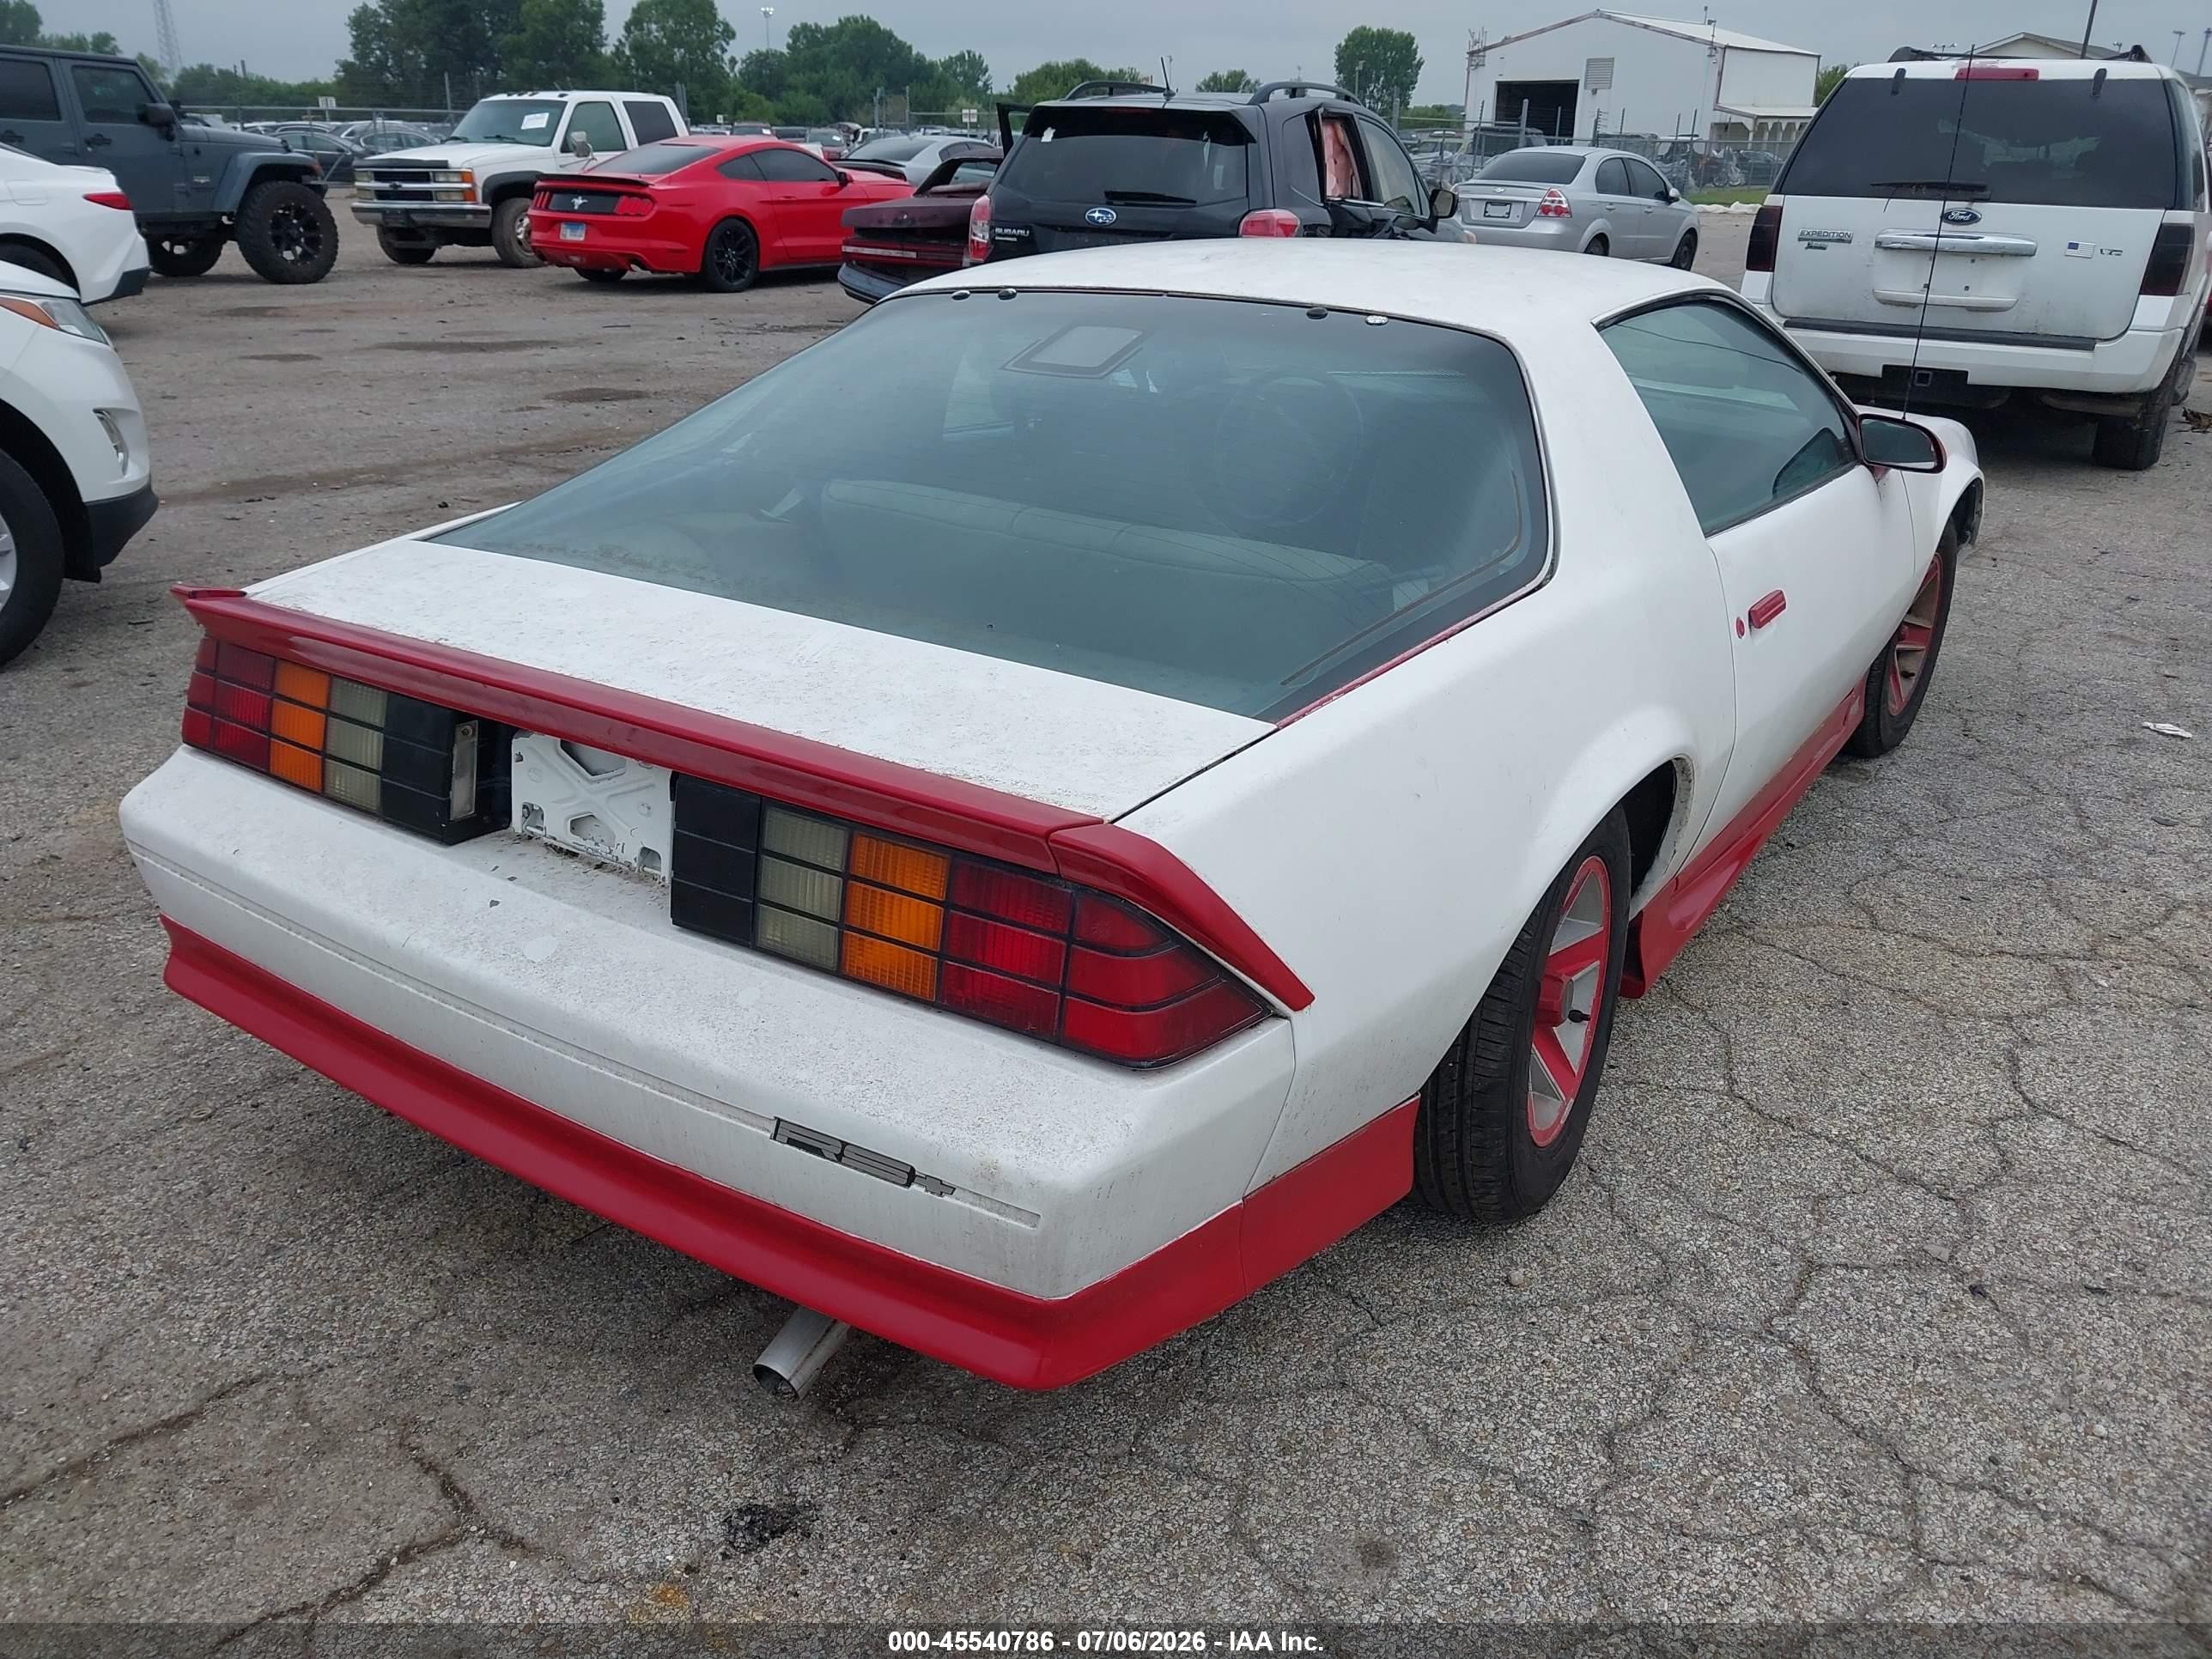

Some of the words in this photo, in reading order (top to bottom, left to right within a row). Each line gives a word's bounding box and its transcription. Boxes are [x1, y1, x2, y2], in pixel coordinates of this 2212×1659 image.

[1948, 211, 1972, 221] Ford
[995, 228, 1030, 237] SUBARU
[1799, 229, 1853, 239] EXPEDITION
